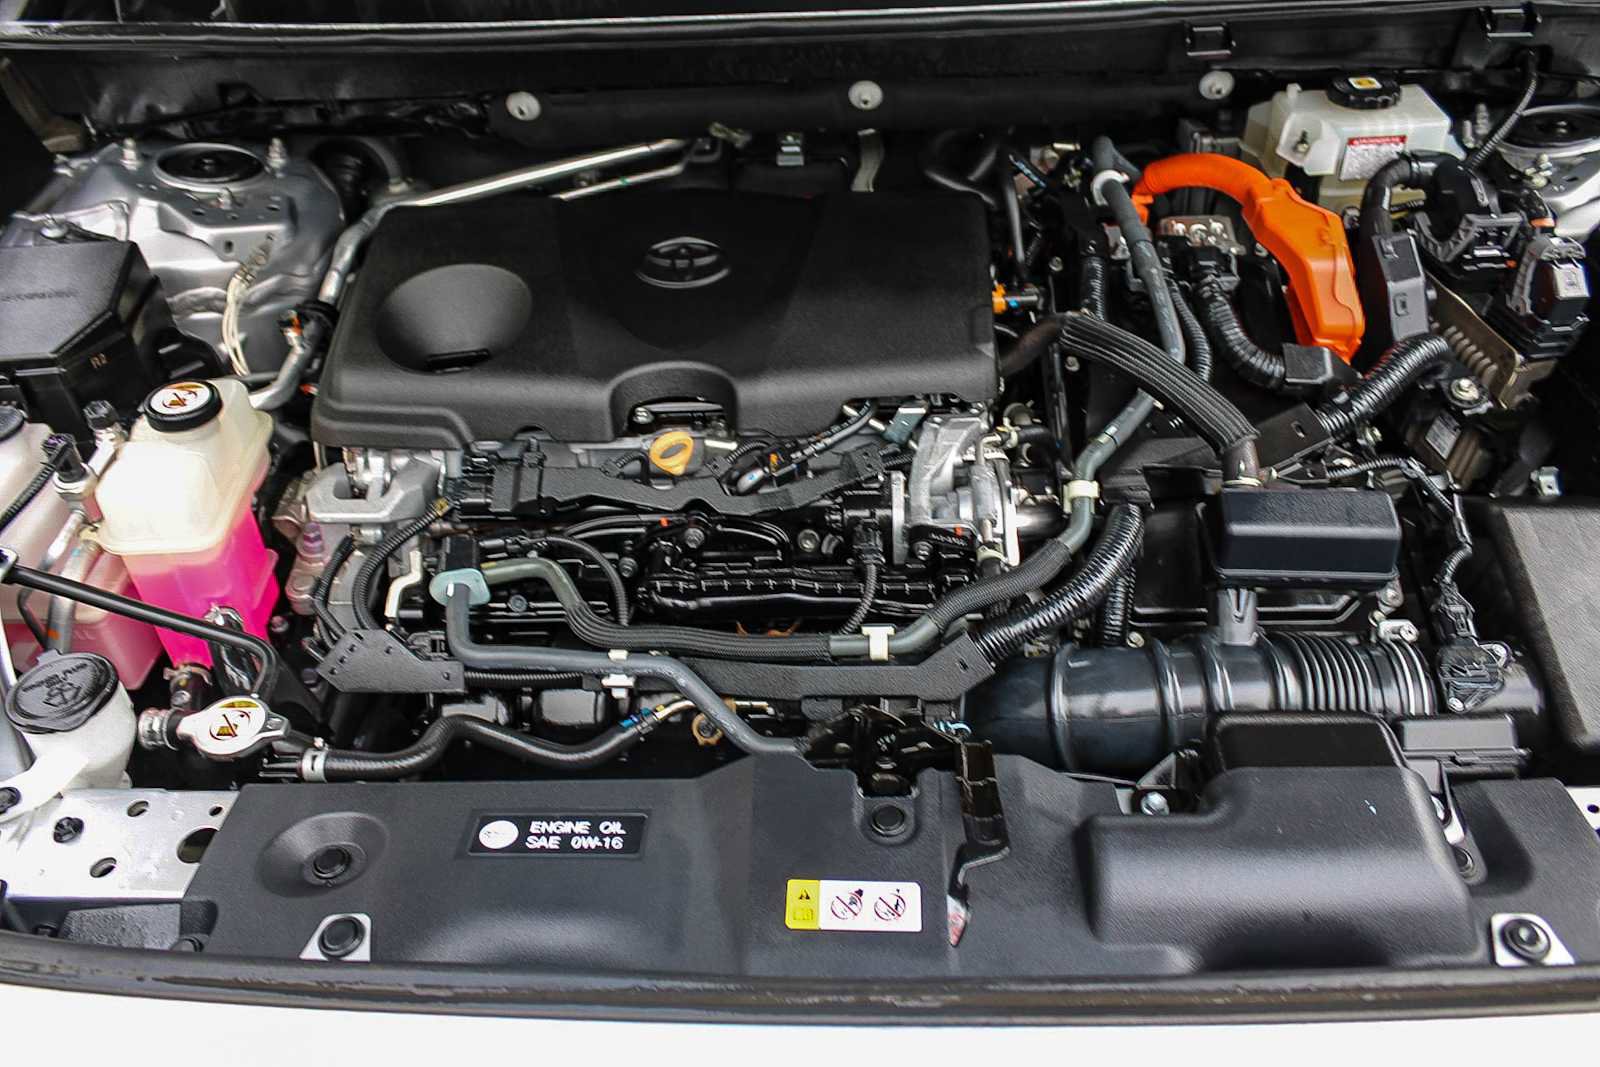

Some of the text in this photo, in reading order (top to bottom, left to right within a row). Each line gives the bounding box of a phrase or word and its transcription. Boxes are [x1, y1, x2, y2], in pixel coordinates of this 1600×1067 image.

[529, 821, 626, 834] ENGINE OIL
[525, 836, 624, 849] SAE 0W-16
